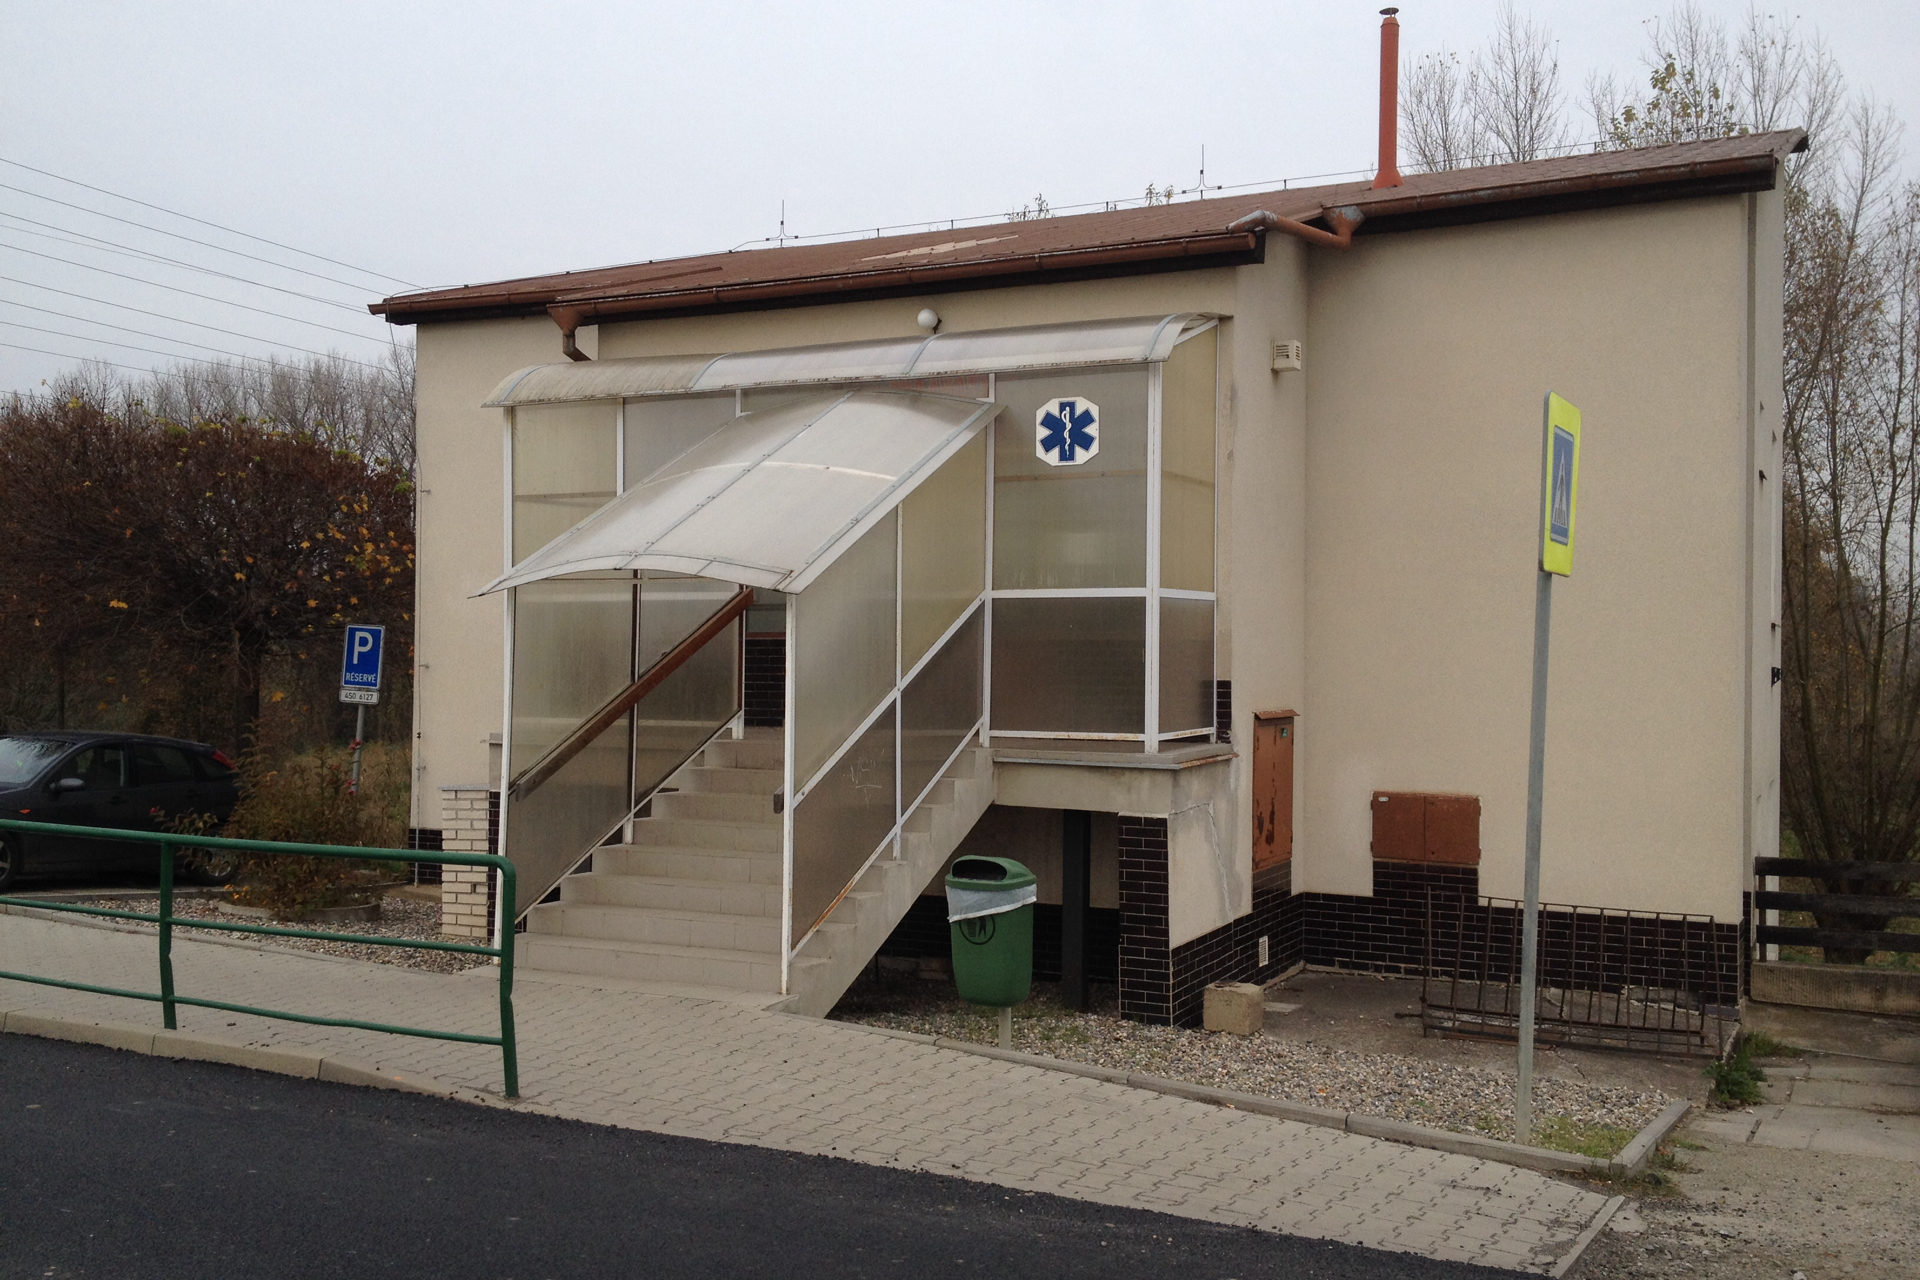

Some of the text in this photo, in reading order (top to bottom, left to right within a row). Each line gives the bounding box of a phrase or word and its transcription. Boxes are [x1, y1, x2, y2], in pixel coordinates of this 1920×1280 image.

[353, 631, 373, 664] P
[345, 672, 376, 683] RÉSERVÉ
[359, 693, 374, 701] 6127
